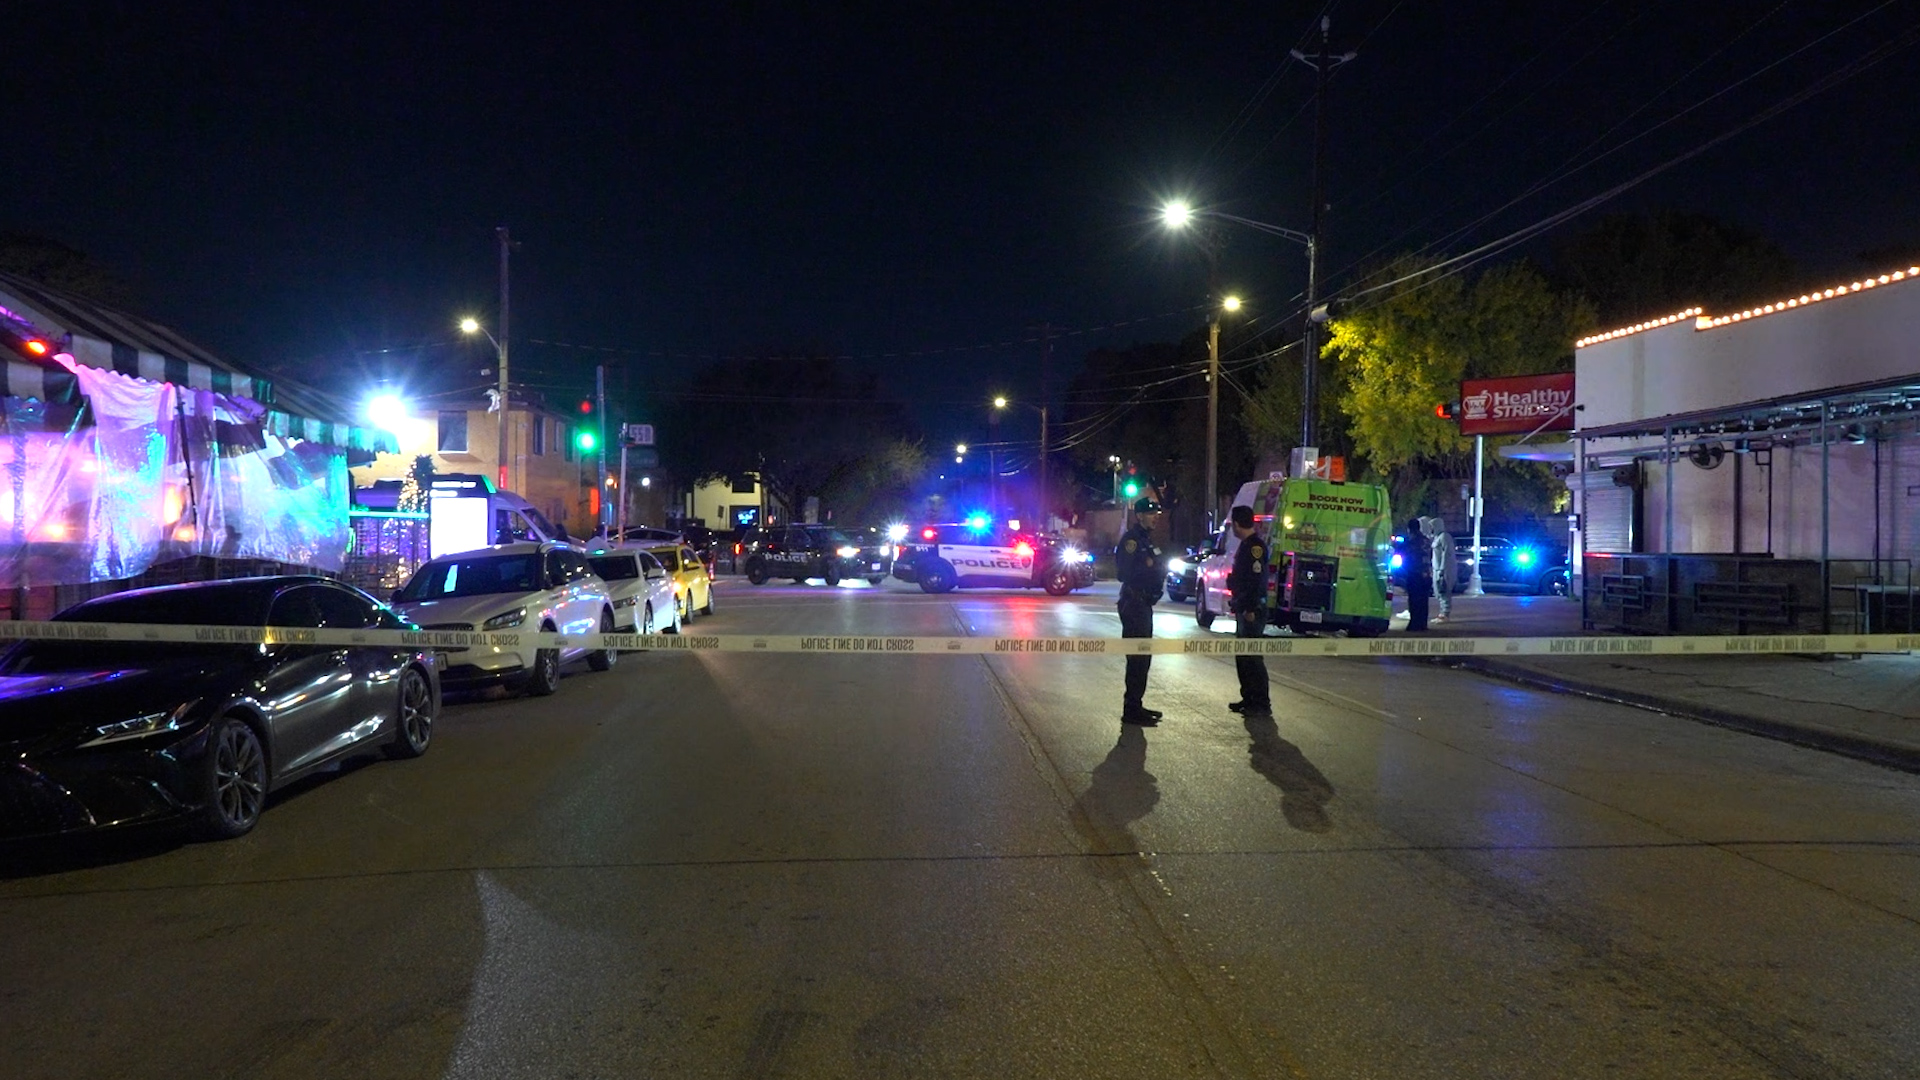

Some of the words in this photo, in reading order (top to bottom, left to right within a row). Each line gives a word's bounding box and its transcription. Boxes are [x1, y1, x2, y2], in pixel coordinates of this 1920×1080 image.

[1493, 389, 1571, 407] Healthy
[1309, 494, 1338, 503] BOOK
[1340, 497, 1364, 505] NOW
[1315, 503, 1344, 511] YOUR
[1346, 506, 1378, 515] EVENT
[765, 552, 808, 563] POLICE
[951, 558, 1022, 569] POLICE
